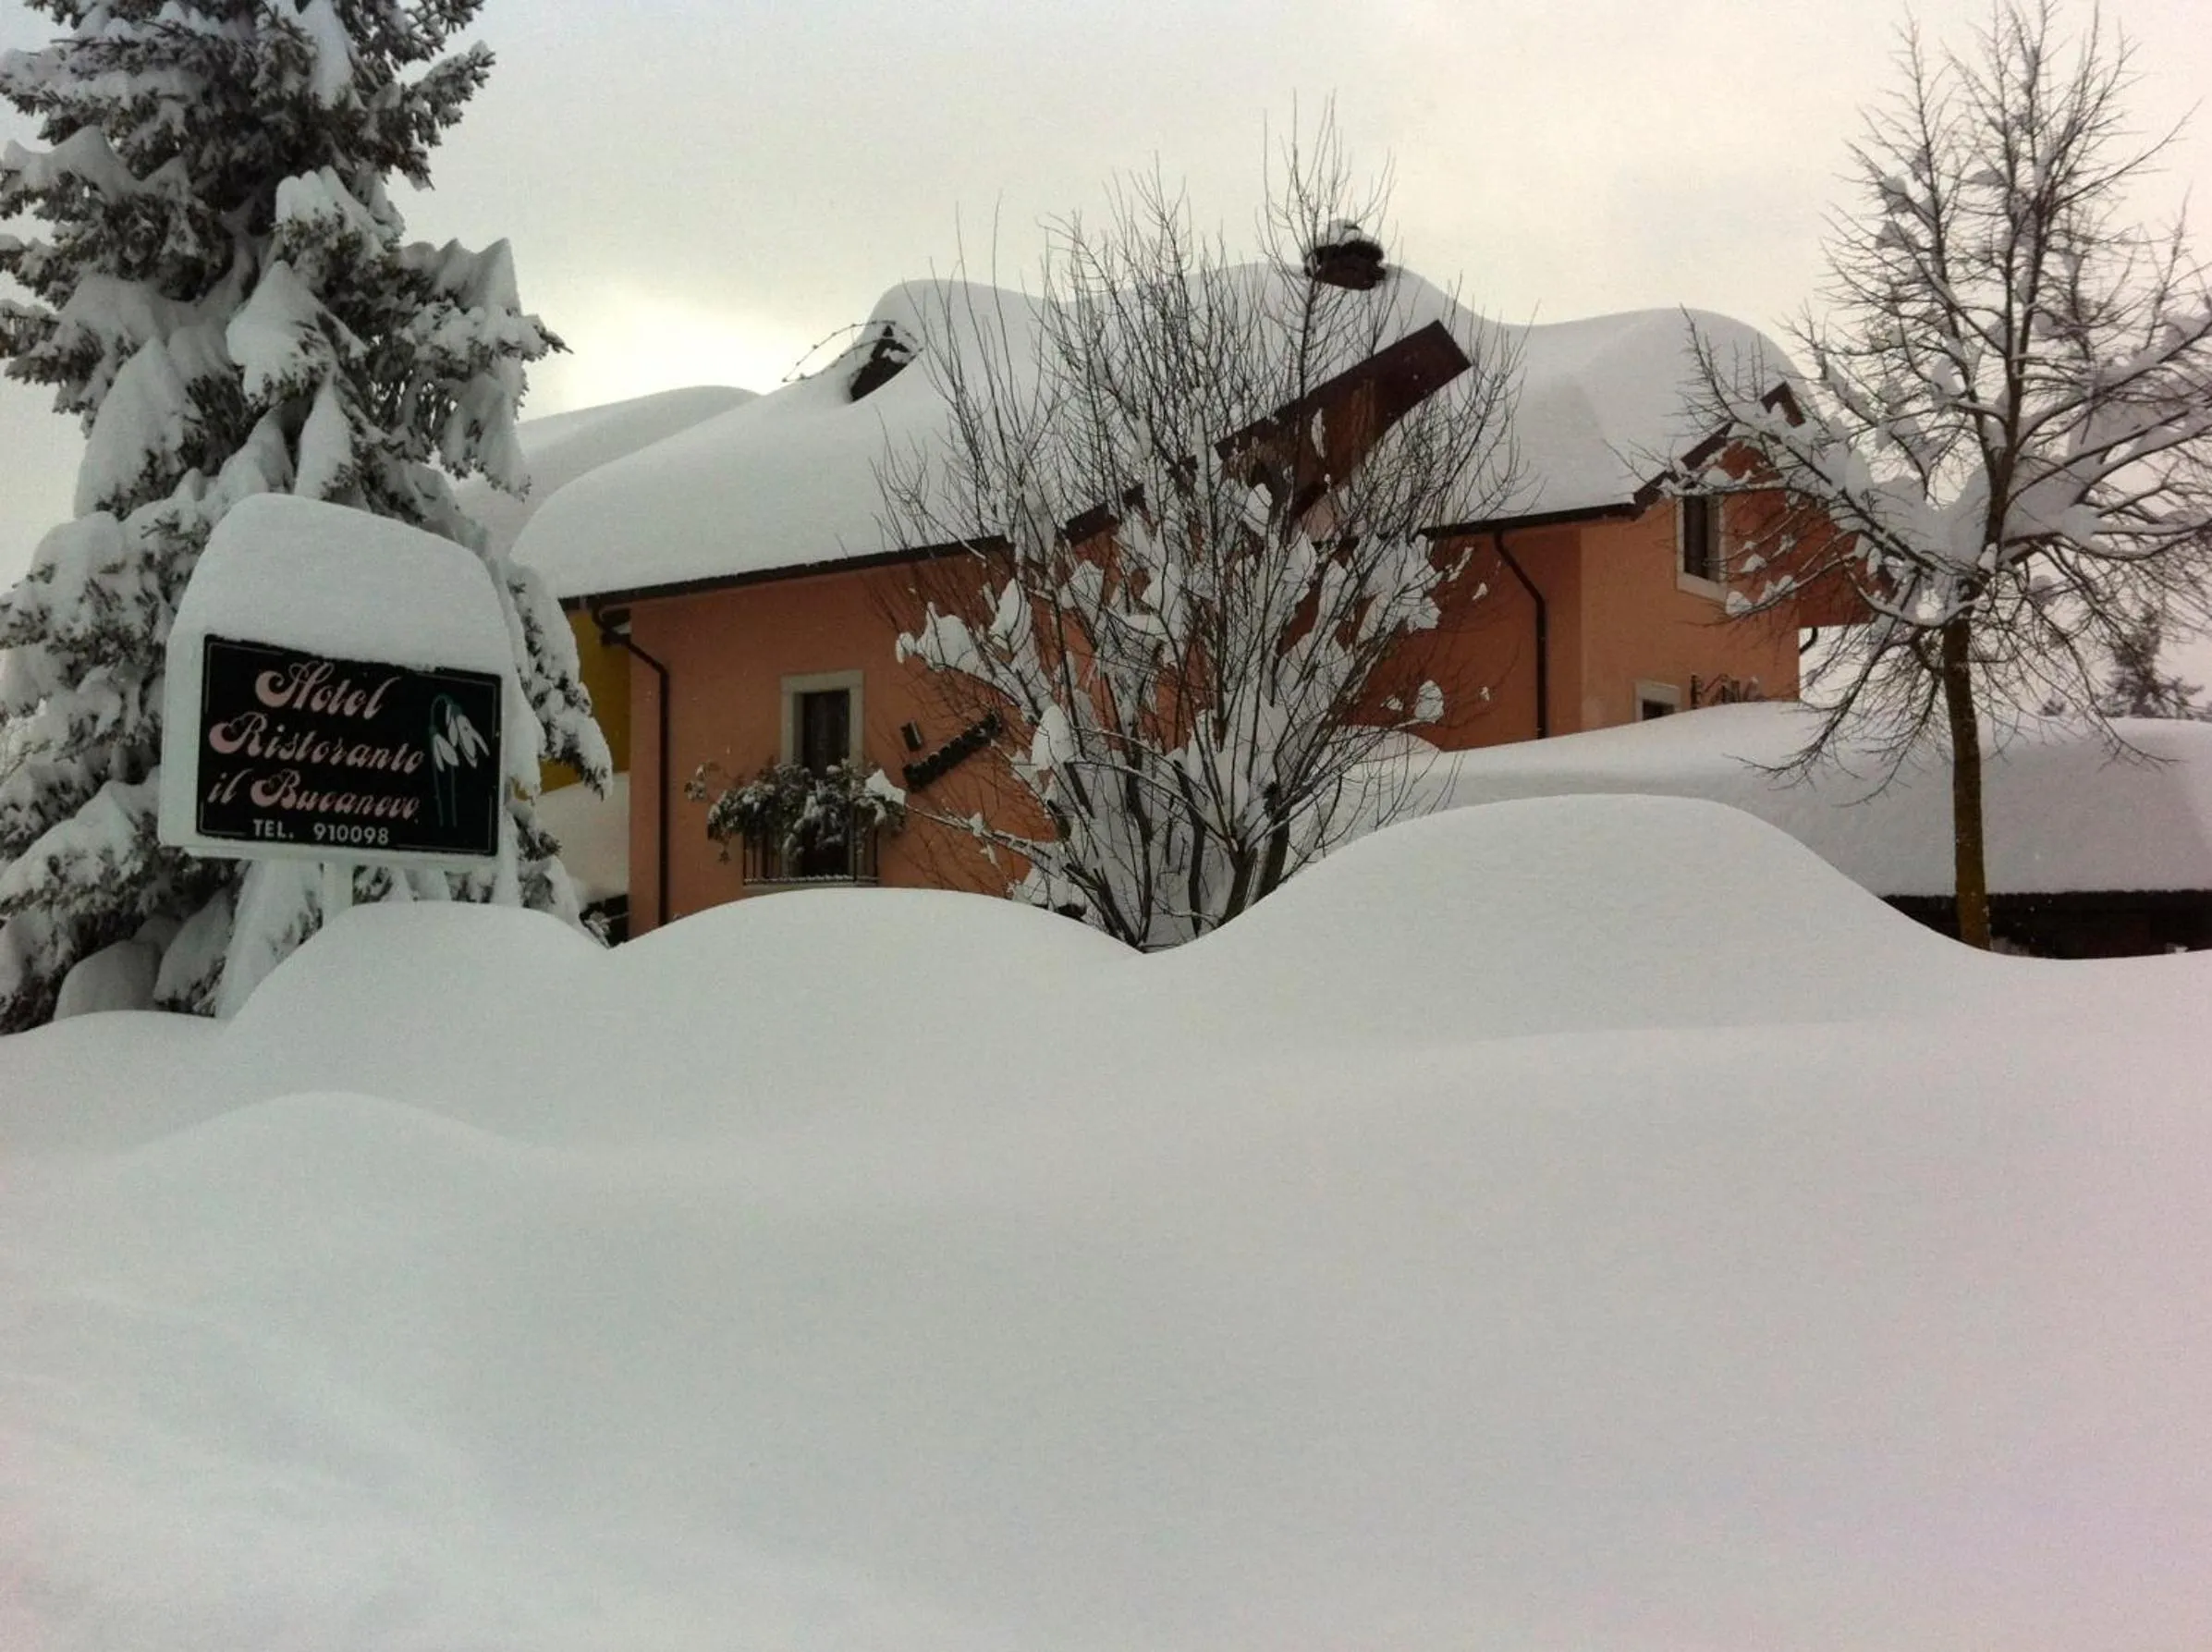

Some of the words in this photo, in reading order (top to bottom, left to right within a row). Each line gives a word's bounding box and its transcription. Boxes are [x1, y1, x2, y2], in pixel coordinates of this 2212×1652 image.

[255, 660, 400, 720] Hotel
[209, 711, 424, 774] Ristorante
[207, 769, 252, 804] il
[251, 768, 419, 820] Bucaneve
[253, 819, 294, 839] TEL.
[313, 822, 389, 845] 910098
